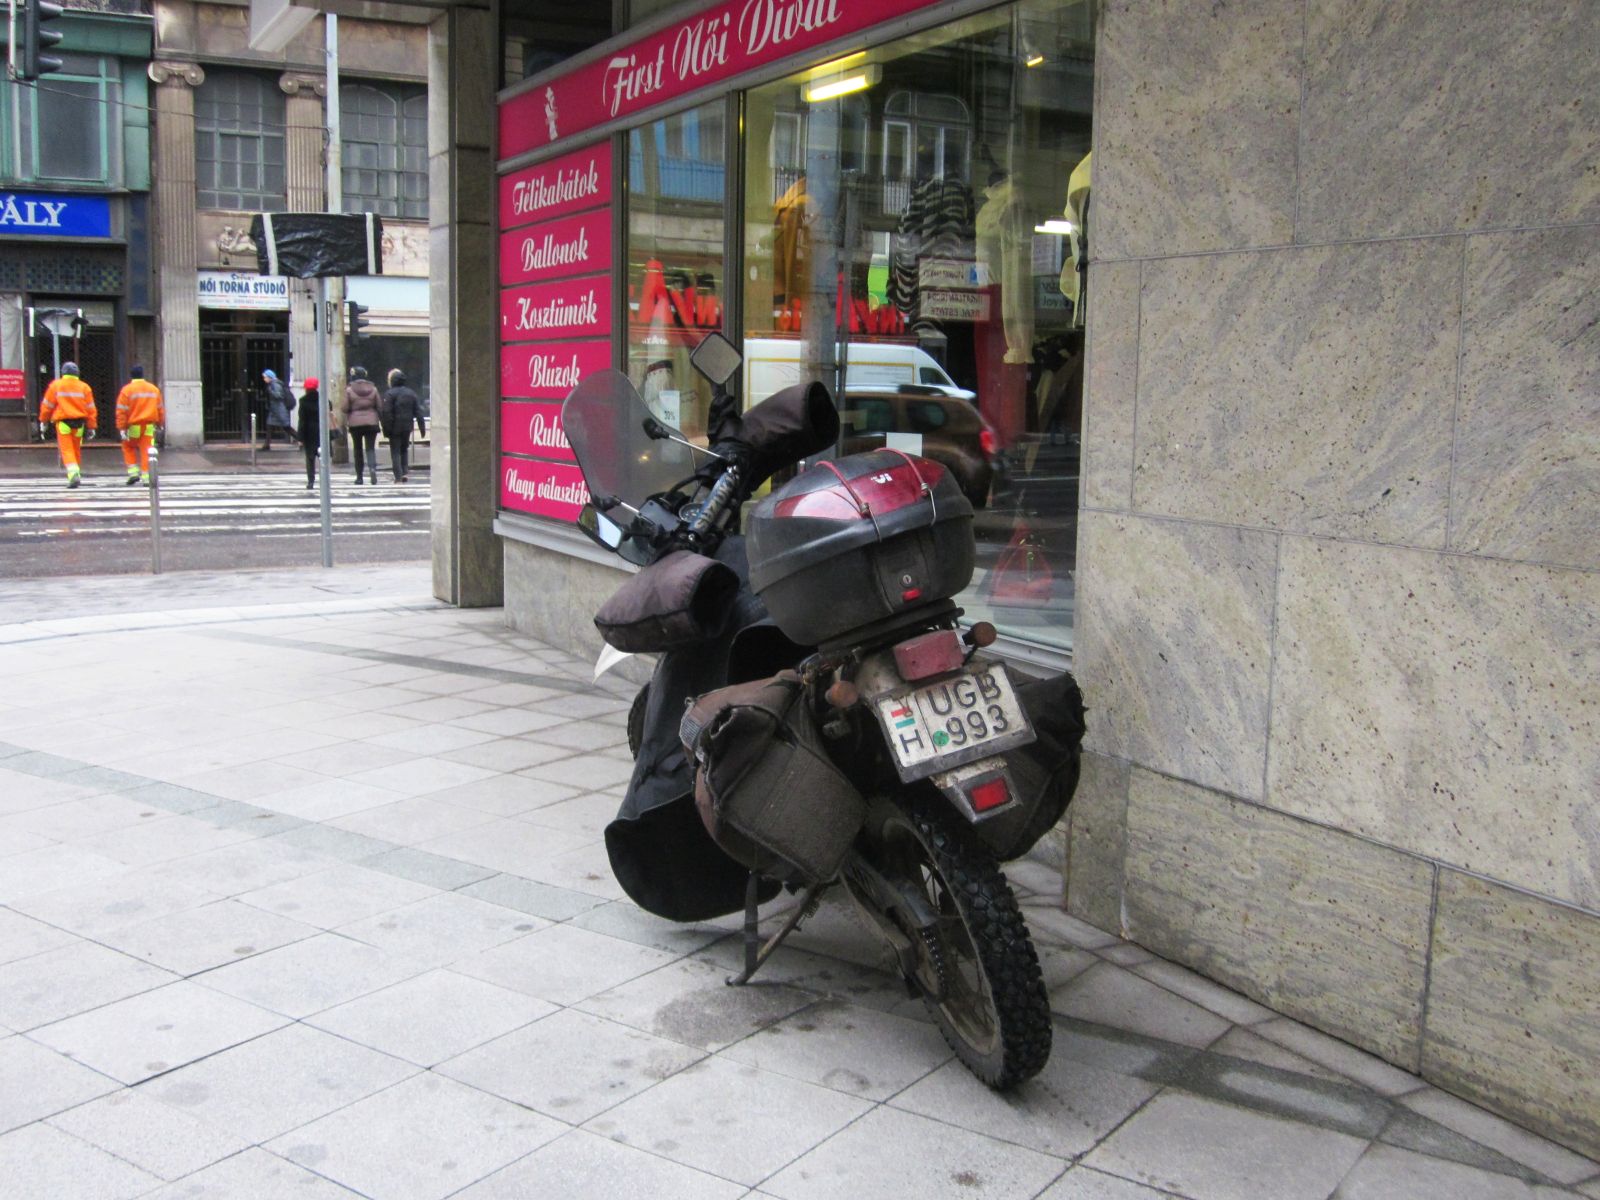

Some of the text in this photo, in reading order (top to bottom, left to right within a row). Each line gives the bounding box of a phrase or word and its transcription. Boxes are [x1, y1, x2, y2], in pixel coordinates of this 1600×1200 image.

[602, 44, 665, 118] First
[512, 159, 599, 216] Télikabátok
[0, 195, 68, 227] ÁLY
[521, 227, 589, 272] Ballonok
[219, 280, 250, 293] TORNA
[253, 280, 286, 295] STÚDIÓ
[515, 290, 598, 332] Kosztümök
[528, 354, 581, 388] Blúzok
[505, 468, 535, 501] Nagy
[926, 673, 1002, 716] UGB
[899, 704, 1008, 753] H 993
